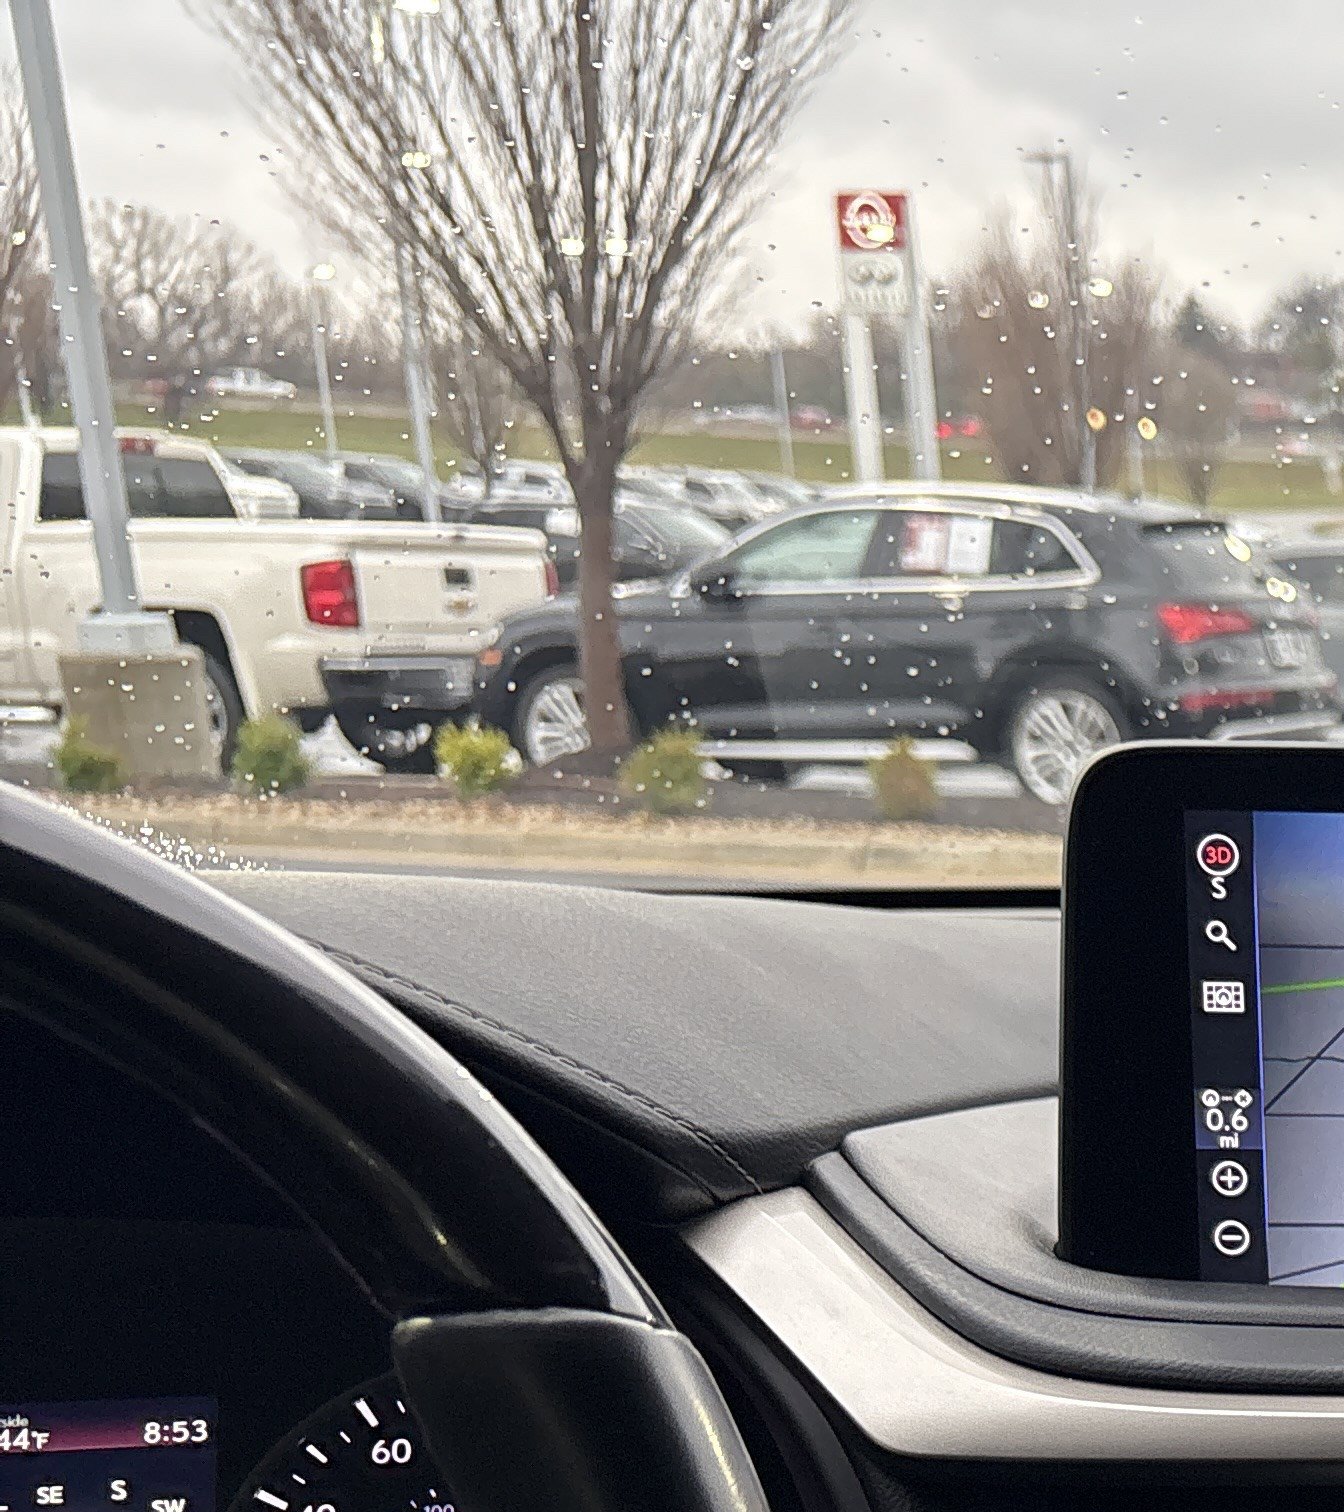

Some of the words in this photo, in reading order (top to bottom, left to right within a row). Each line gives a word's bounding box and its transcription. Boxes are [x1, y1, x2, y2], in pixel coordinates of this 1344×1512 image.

[1205, 844, 1232, 865] 3D
[1210, 875, 1228, 900] S
[1205, 1107, 1249, 1132] 0.6
[1219, 1131, 1239, 1149] mi
[143, 1419, 209, 1445] 8:53
[371, 1438, 412, 1465] 60
[36, 1485, 65, 1506] SE
[110, 1479, 129, 1502] S
